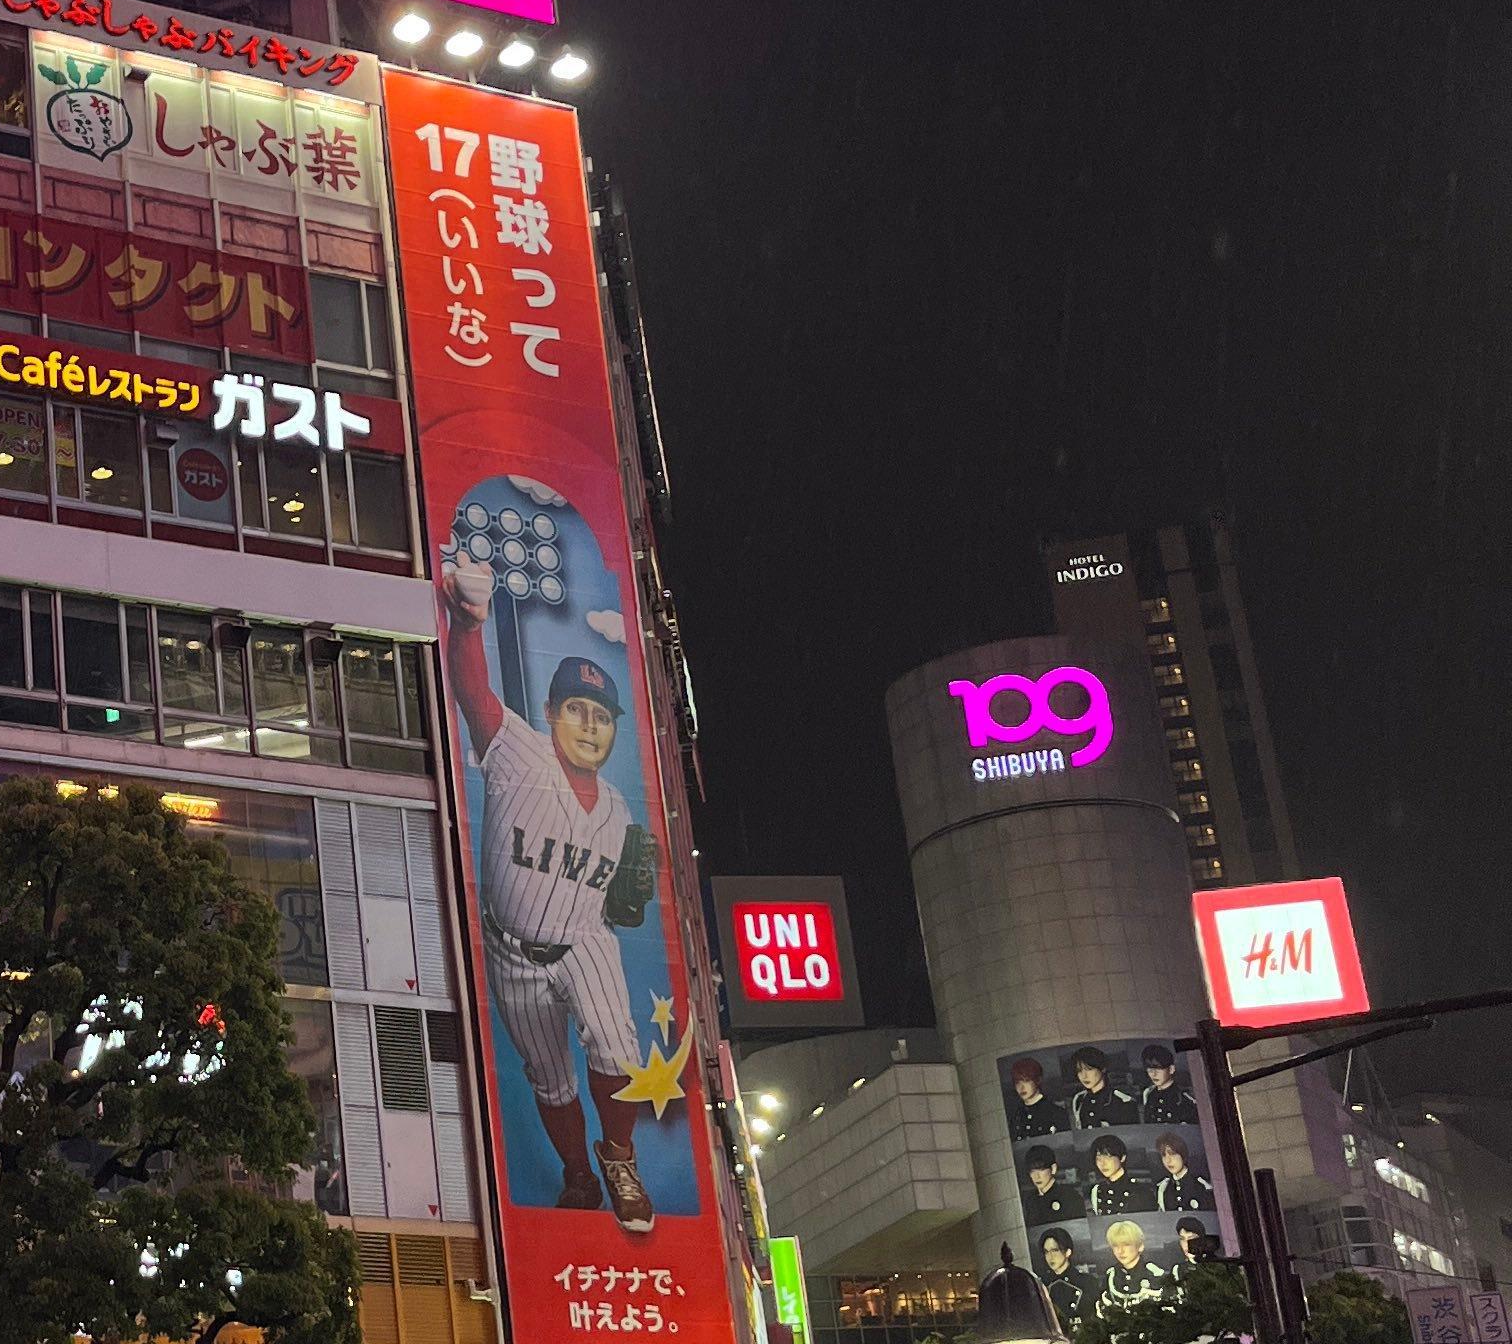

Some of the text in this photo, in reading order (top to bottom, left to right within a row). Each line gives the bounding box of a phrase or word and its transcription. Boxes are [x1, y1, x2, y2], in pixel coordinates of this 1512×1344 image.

[155, 91, 362, 193] しゃぶ葉
[488, 133, 562, 378] 野球って
[212, 372, 372, 452] ガスト
[1056, 561, 1124, 584] INDIGO
[1069, 553, 1106, 566] HOTEL
[949, 666, 1114, 767] 109
[971, 748, 1065, 782] SHIBUYA
[512, 824, 616, 893] LIVE
[743, 912, 819, 949] UNI
[750, 952, 831, 995] QLO
[1244, 927, 1313, 980] H&M
[553, 1263, 686, 1297] イチナナで、
[569, 1301, 679, 1333] 叶えよう。
